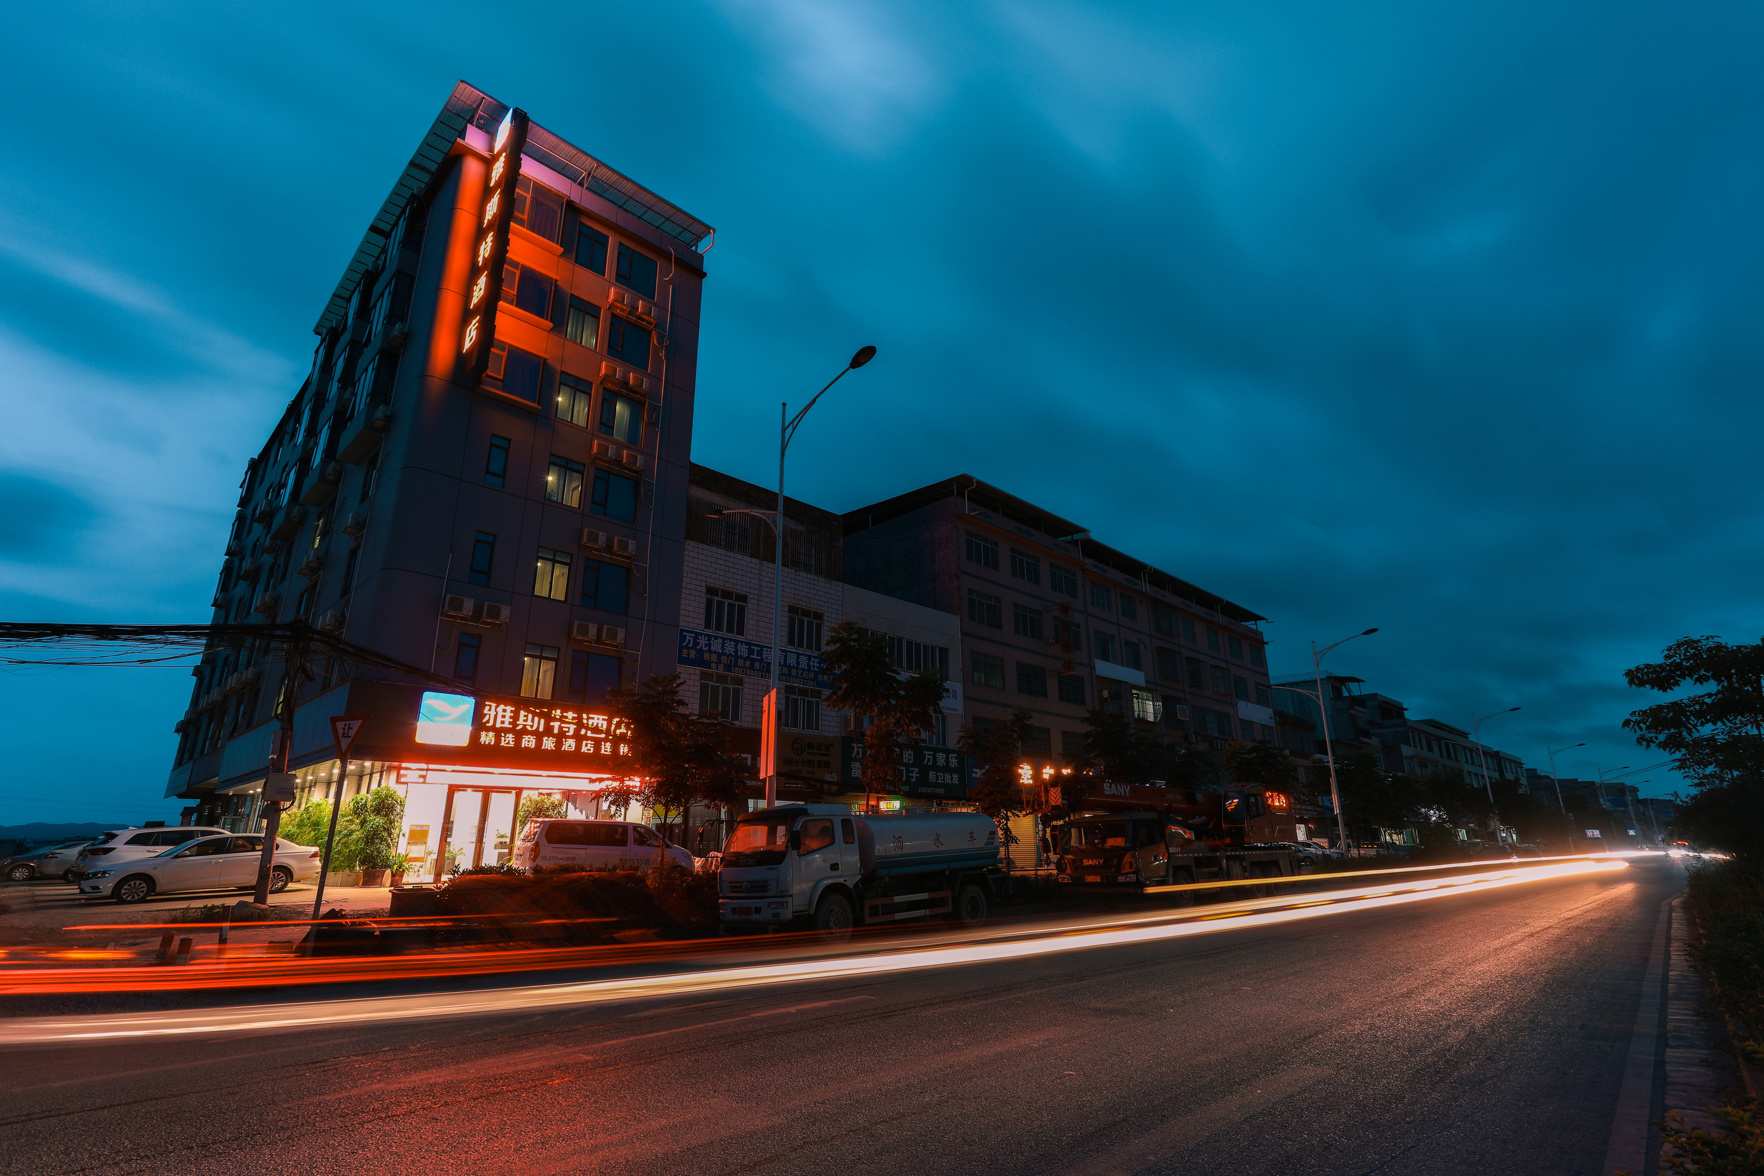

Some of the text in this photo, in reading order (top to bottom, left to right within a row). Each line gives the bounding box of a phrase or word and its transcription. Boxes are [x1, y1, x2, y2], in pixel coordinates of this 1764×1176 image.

[462, 152, 507, 354] 雅斯特酒店
[341, 722, 353, 739] 让
[923, 749, 959, 769] 万家乐
[928, 771, 960, 785] 厨卫批发
[1103, 782, 1131, 797] SANY
[1082, 858, 1104, 866] SANY
